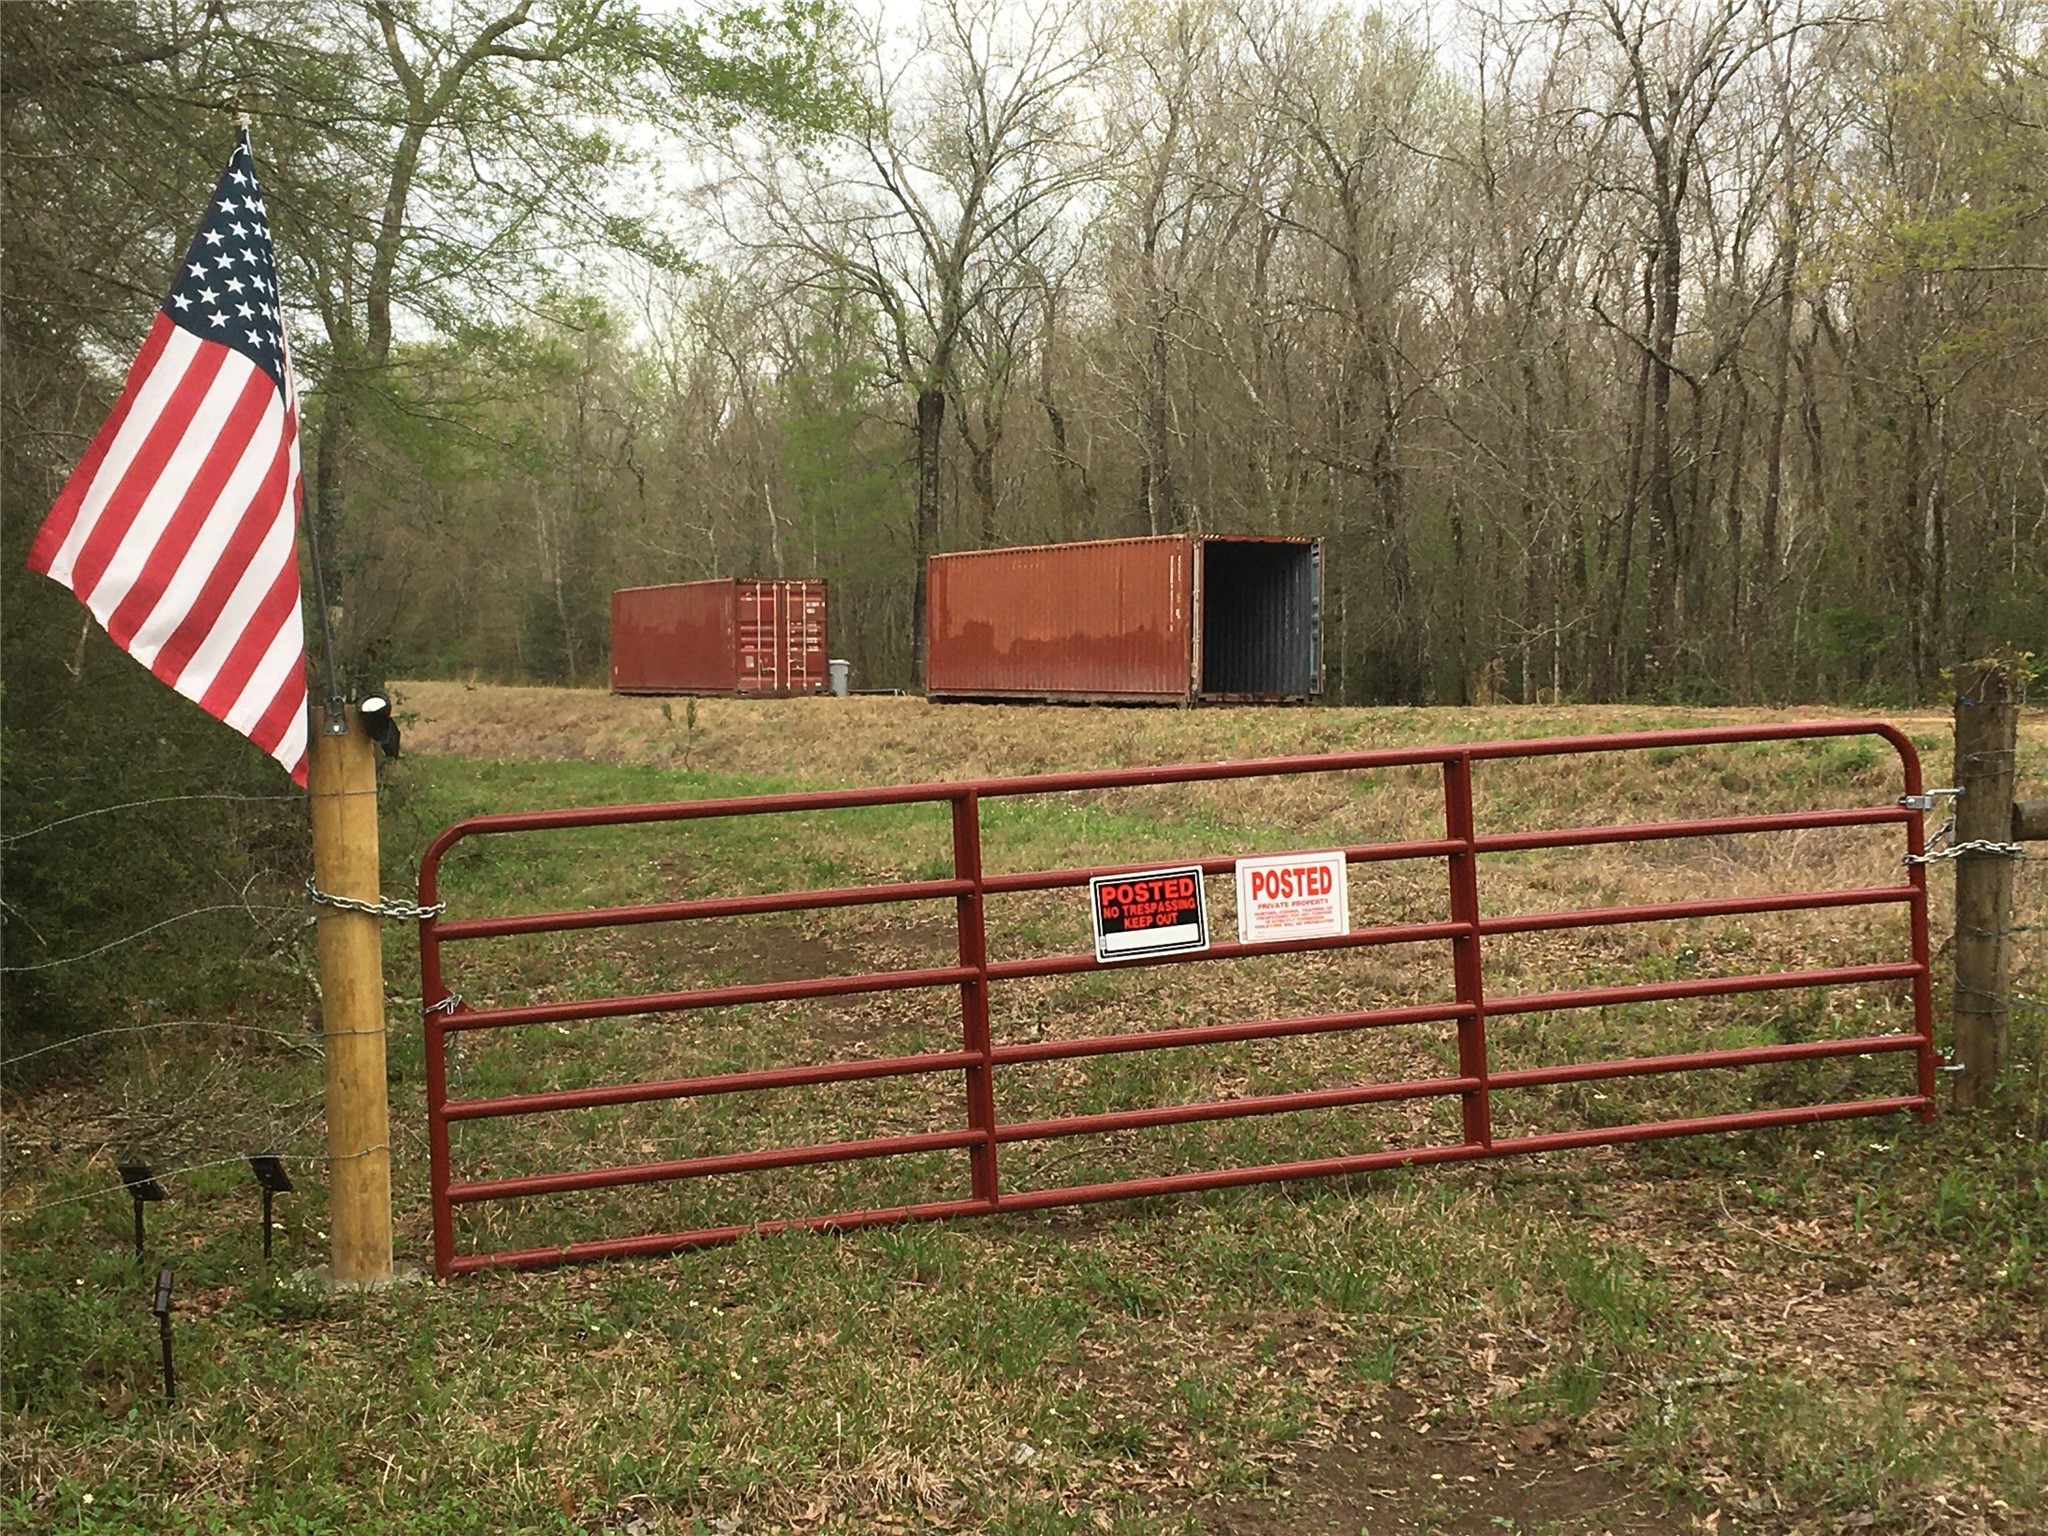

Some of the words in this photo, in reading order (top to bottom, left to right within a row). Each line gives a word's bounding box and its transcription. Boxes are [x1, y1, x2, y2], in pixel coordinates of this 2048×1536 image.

[1101, 877, 1194, 906] POSTED
[1251, 865, 1333, 900] POSTED
[1103, 906, 1120, 919] NO
[1122, 897, 1196, 916] TRESPASSING
[1257, 901, 1289, 909] PRIVATE
[1291, 898, 1329, 907] PROPERTY
[1124, 916, 1153, 929] KEEP
[1156, 912, 1178, 925] OUT
